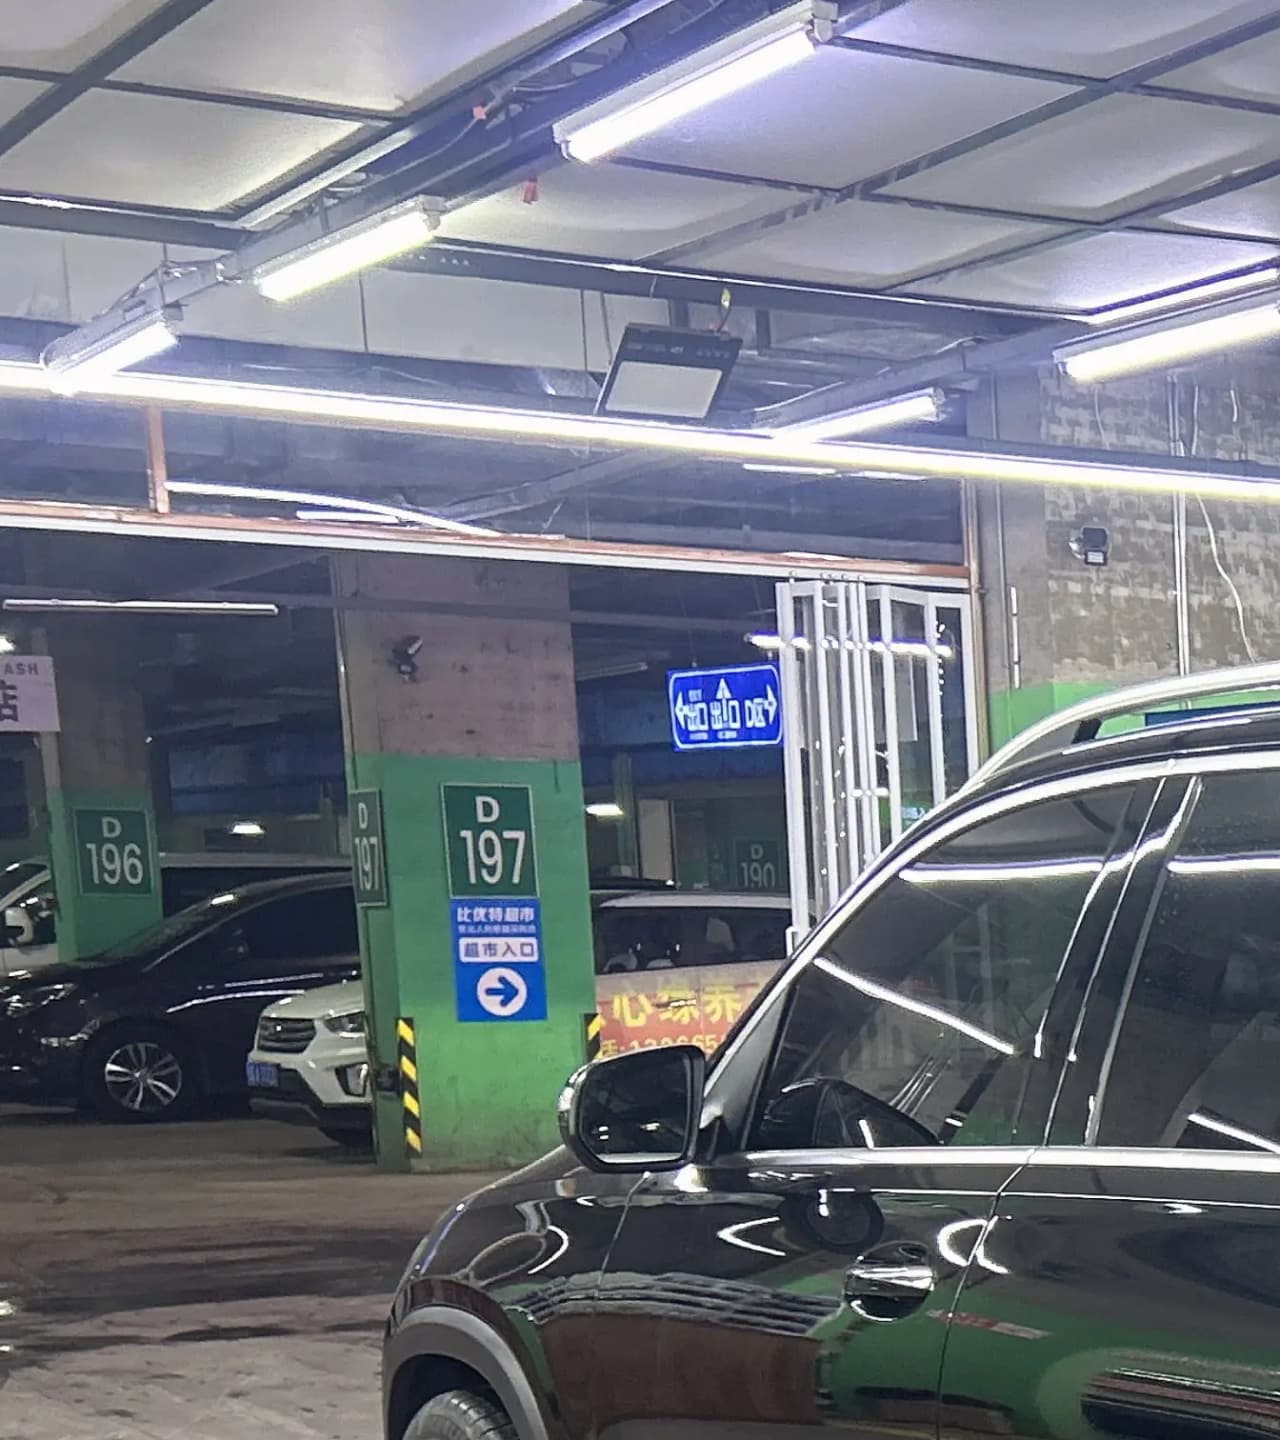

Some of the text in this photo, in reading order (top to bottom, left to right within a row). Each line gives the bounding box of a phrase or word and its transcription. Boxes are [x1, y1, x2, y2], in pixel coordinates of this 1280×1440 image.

[358, 802, 369, 829] D
[475, 796, 500, 823] D
[102, 816, 122, 838] D
[85, 842, 143, 885] 196
[354, 836, 379, 891] 197
[459, 829, 526, 885] 197
[464, 942, 534, 958] 超市入口
